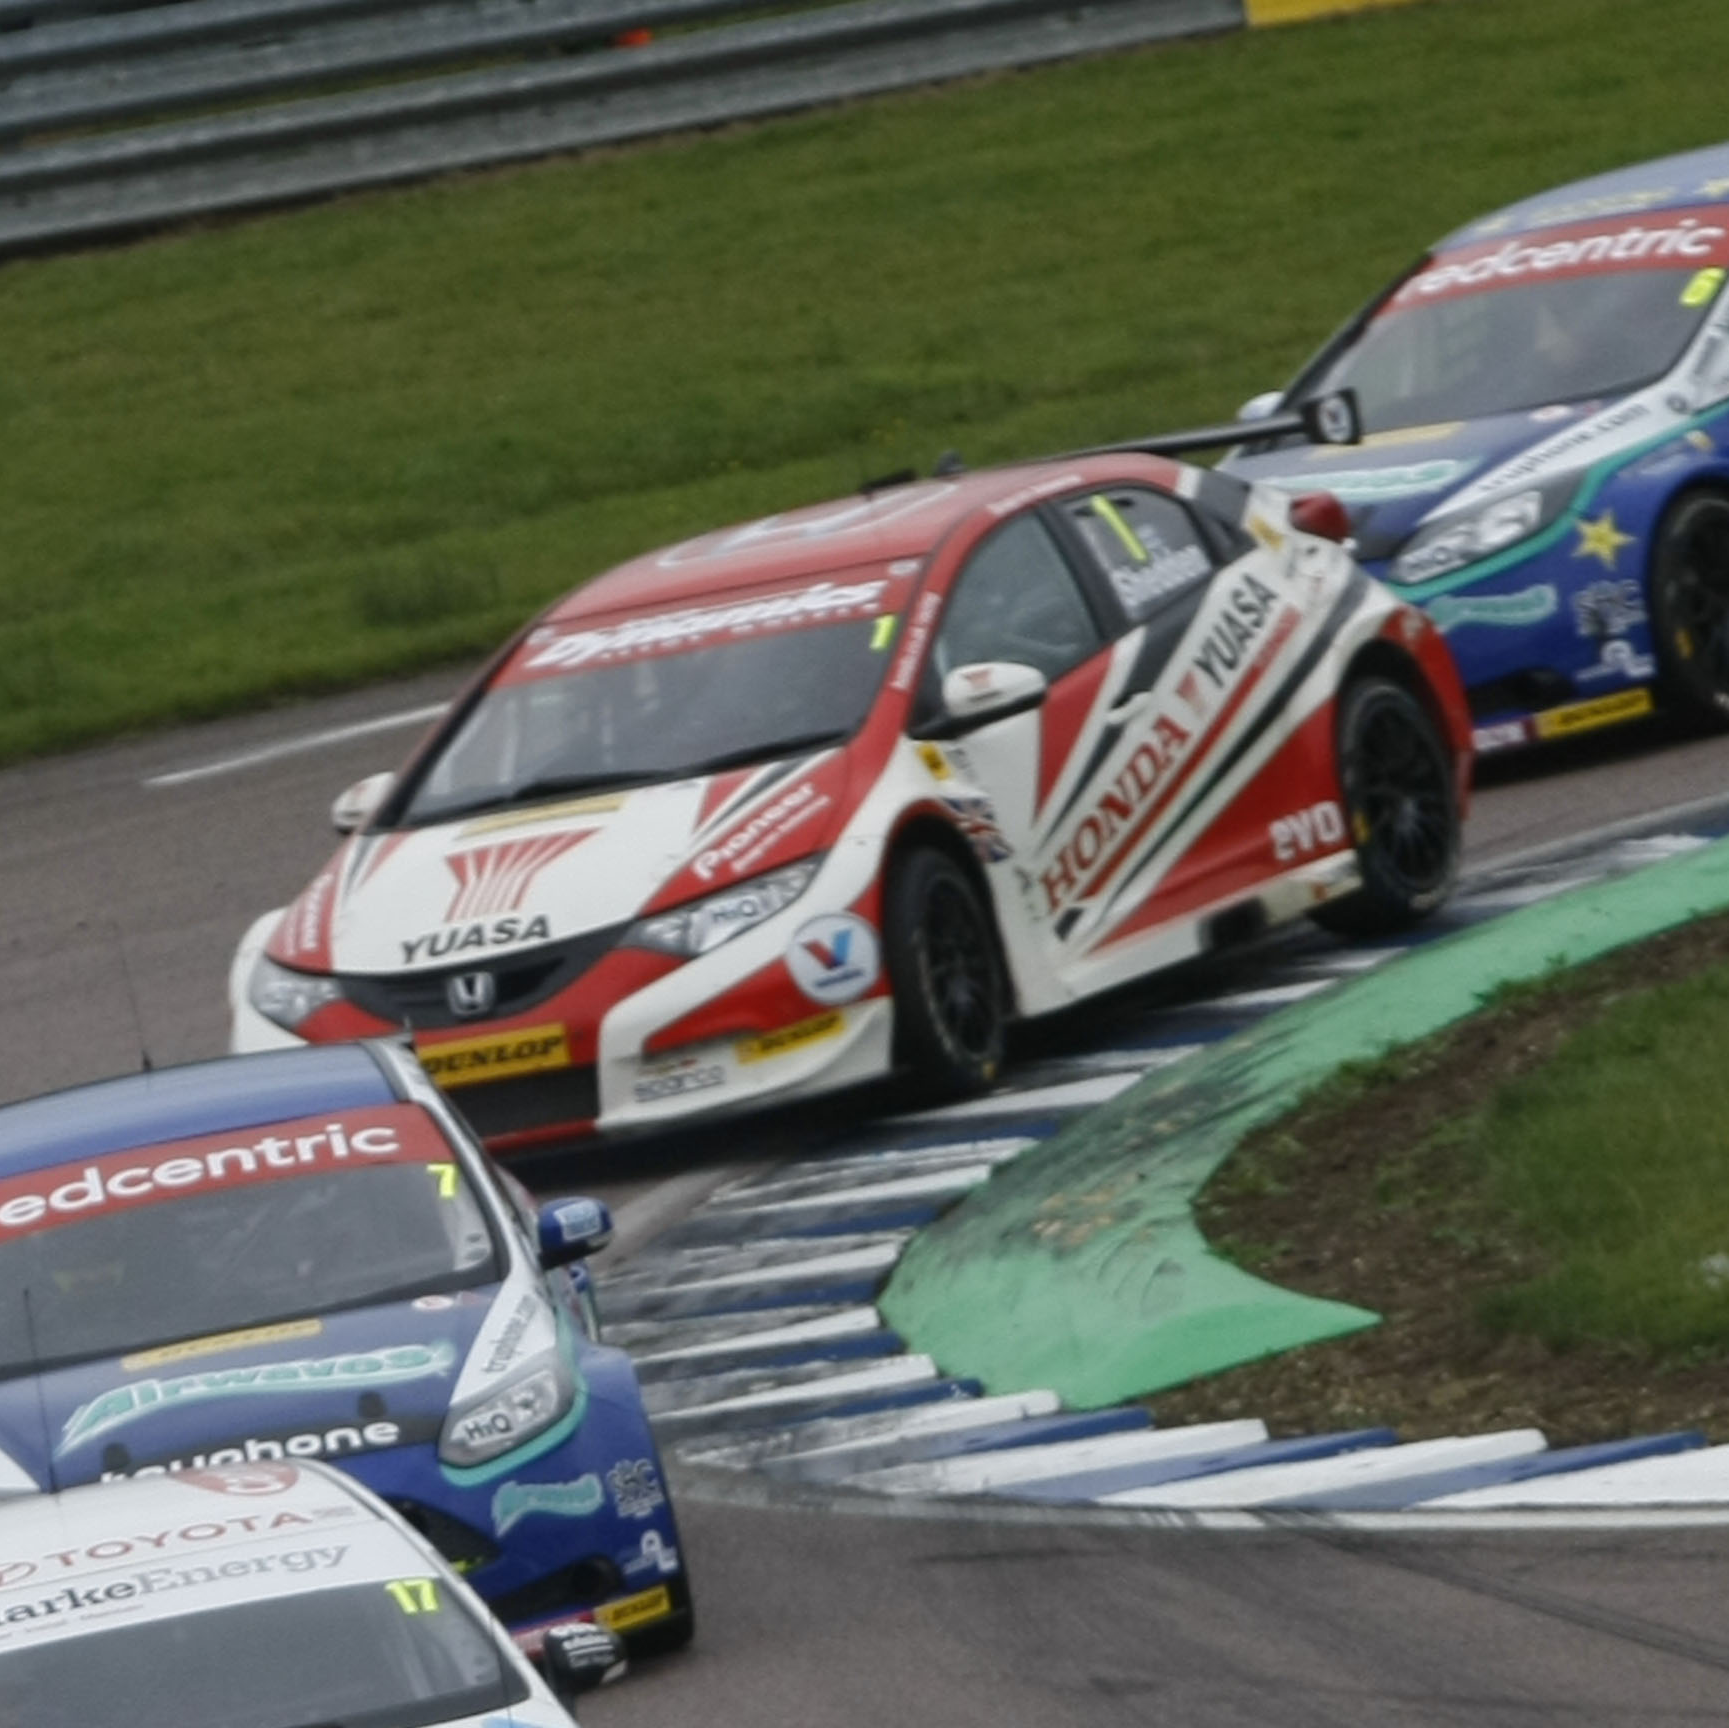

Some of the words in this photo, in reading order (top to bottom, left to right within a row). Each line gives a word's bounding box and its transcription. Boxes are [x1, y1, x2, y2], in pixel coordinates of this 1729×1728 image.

[1390, 217, 1727, 302] redcentric
[870, 613, 897, 651] 1
[1193, 573, 1279, 688] YUASA
[1037, 713, 1192, 915] HONDA
[400, 914, 551, 965] YUASA
[425, 1035, 563, 1075] DUNLOP
[427, 1162, 461, 1199] 7
[100, 1420, 402, 1483] uphone
[465, 1413, 512, 1441] HiQ
[40, 1511, 313, 1570] TOYOTA
[385, 1578, 442, 1615] 17
